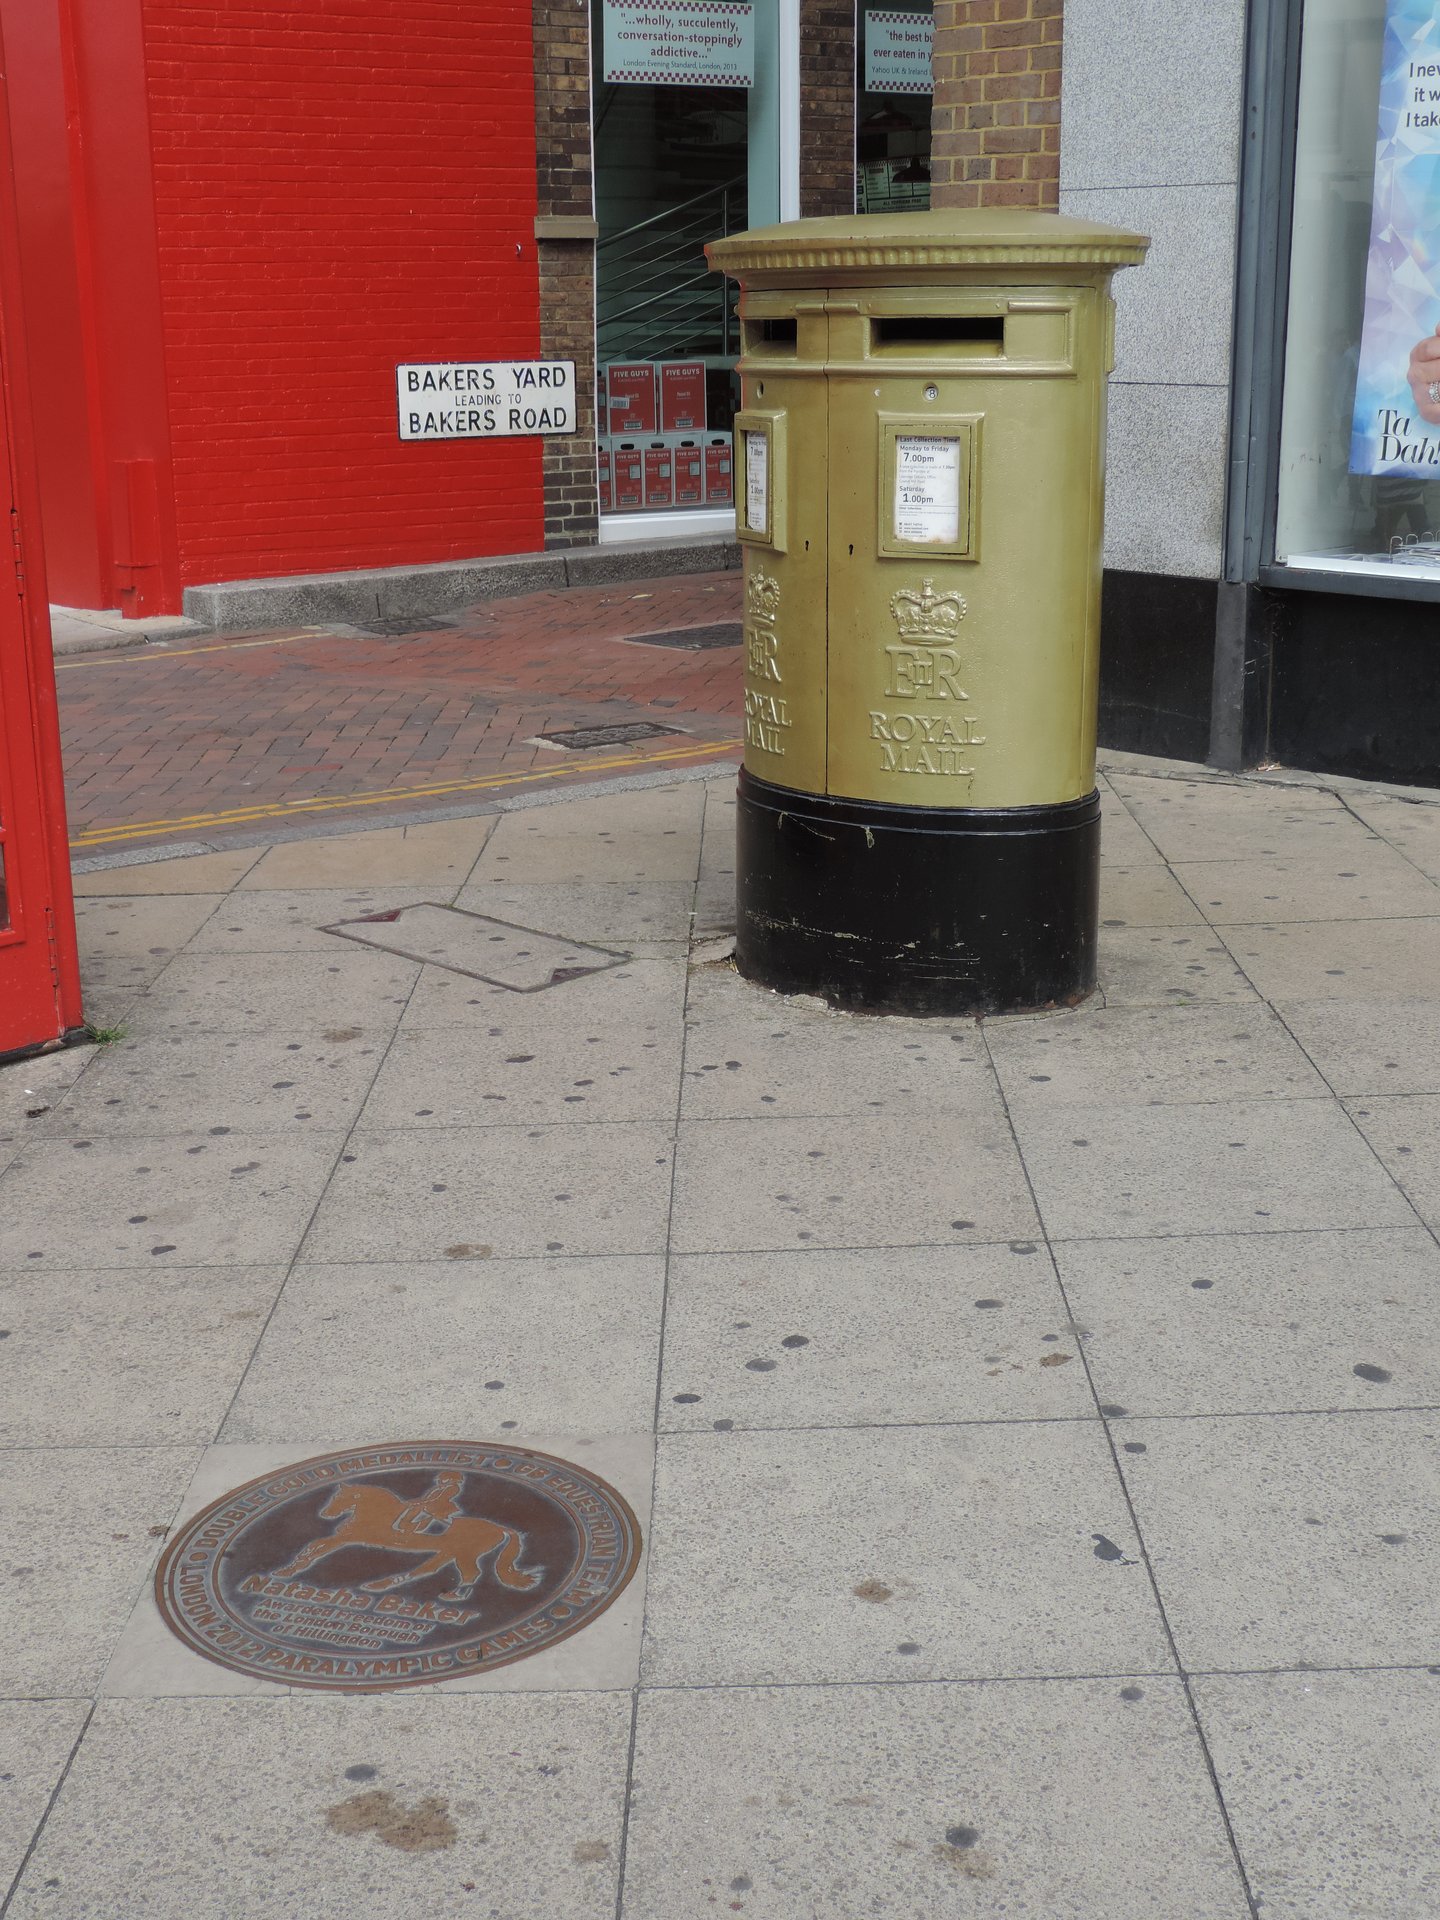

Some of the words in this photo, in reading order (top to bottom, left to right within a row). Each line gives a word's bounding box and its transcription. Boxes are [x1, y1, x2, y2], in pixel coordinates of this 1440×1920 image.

[621, 12, 674, 28] "...wholly,
[678, 17, 739, 32] succulently,
[617, 31, 742, 48] conversation-stoppingly
[905, 31, 922, 42] best
[650, 46, 712, 58] addictive..."
[873, 49, 891, 58] ever
[893, 49, 916, 59] eaten
[918, 49, 926, 60] in
[648, 60, 670, 69] Evening
[671, 61, 698, 70] Standard,
[699, 62, 722, 71] London,
[872, 66, 890, 74] Yahoo
[892, 66, 900, 74] UK
[908, 66, 928, 75] Ireland
[1414, 87, 1425, 102] it
[1414, 112, 1440, 128] tak
[408, 369, 495, 392] BAKERS
[512, 367, 566, 388] YARD
[455, 394, 502, 406] LEADING
[508, 394, 521, 404] TO
[410, 410, 496, 434] BAKERS
[509, 407, 566, 430] ROAD
[1378, 410, 1411, 436] Ta
[904, 452, 934, 463] 7.00pm
[903, 493, 934, 504] 1.00pm
[869, 711, 986, 745] ROYAL
[880, 743, 975, 776] MAIL
[194, 1493, 267, 1549] DOUBLE
[267, 1467, 335, 1497] GOLD
[338, 1451, 488, 1473] MEDALLIST
[514, 1463, 547, 1482] GB
[545, 1474, 618, 1559] EQUESTRIAN
[240, 1575, 371, 1610] Natasha
[375, 1595, 480, 1625] Baker
[179, 1564, 221, 1629] LONDON
[205, 1624, 266, 1659] 2012
[262, 1648, 452, 1676] PARALYMPIC
[456, 1617, 556, 1663] GAMES
[253, 1608, 281, 1621] the
[283, 1612, 346, 1630] London
[349, 1620, 421, 1644] Borough
[259, 1599, 336, 1618] Awarded
[338, 1610, 408, 1629] Freedom
[410, 1622, 433, 1634] of
[272, 1624, 292, 1634] of
[293, 1627, 381, 1650] Hillingdon
